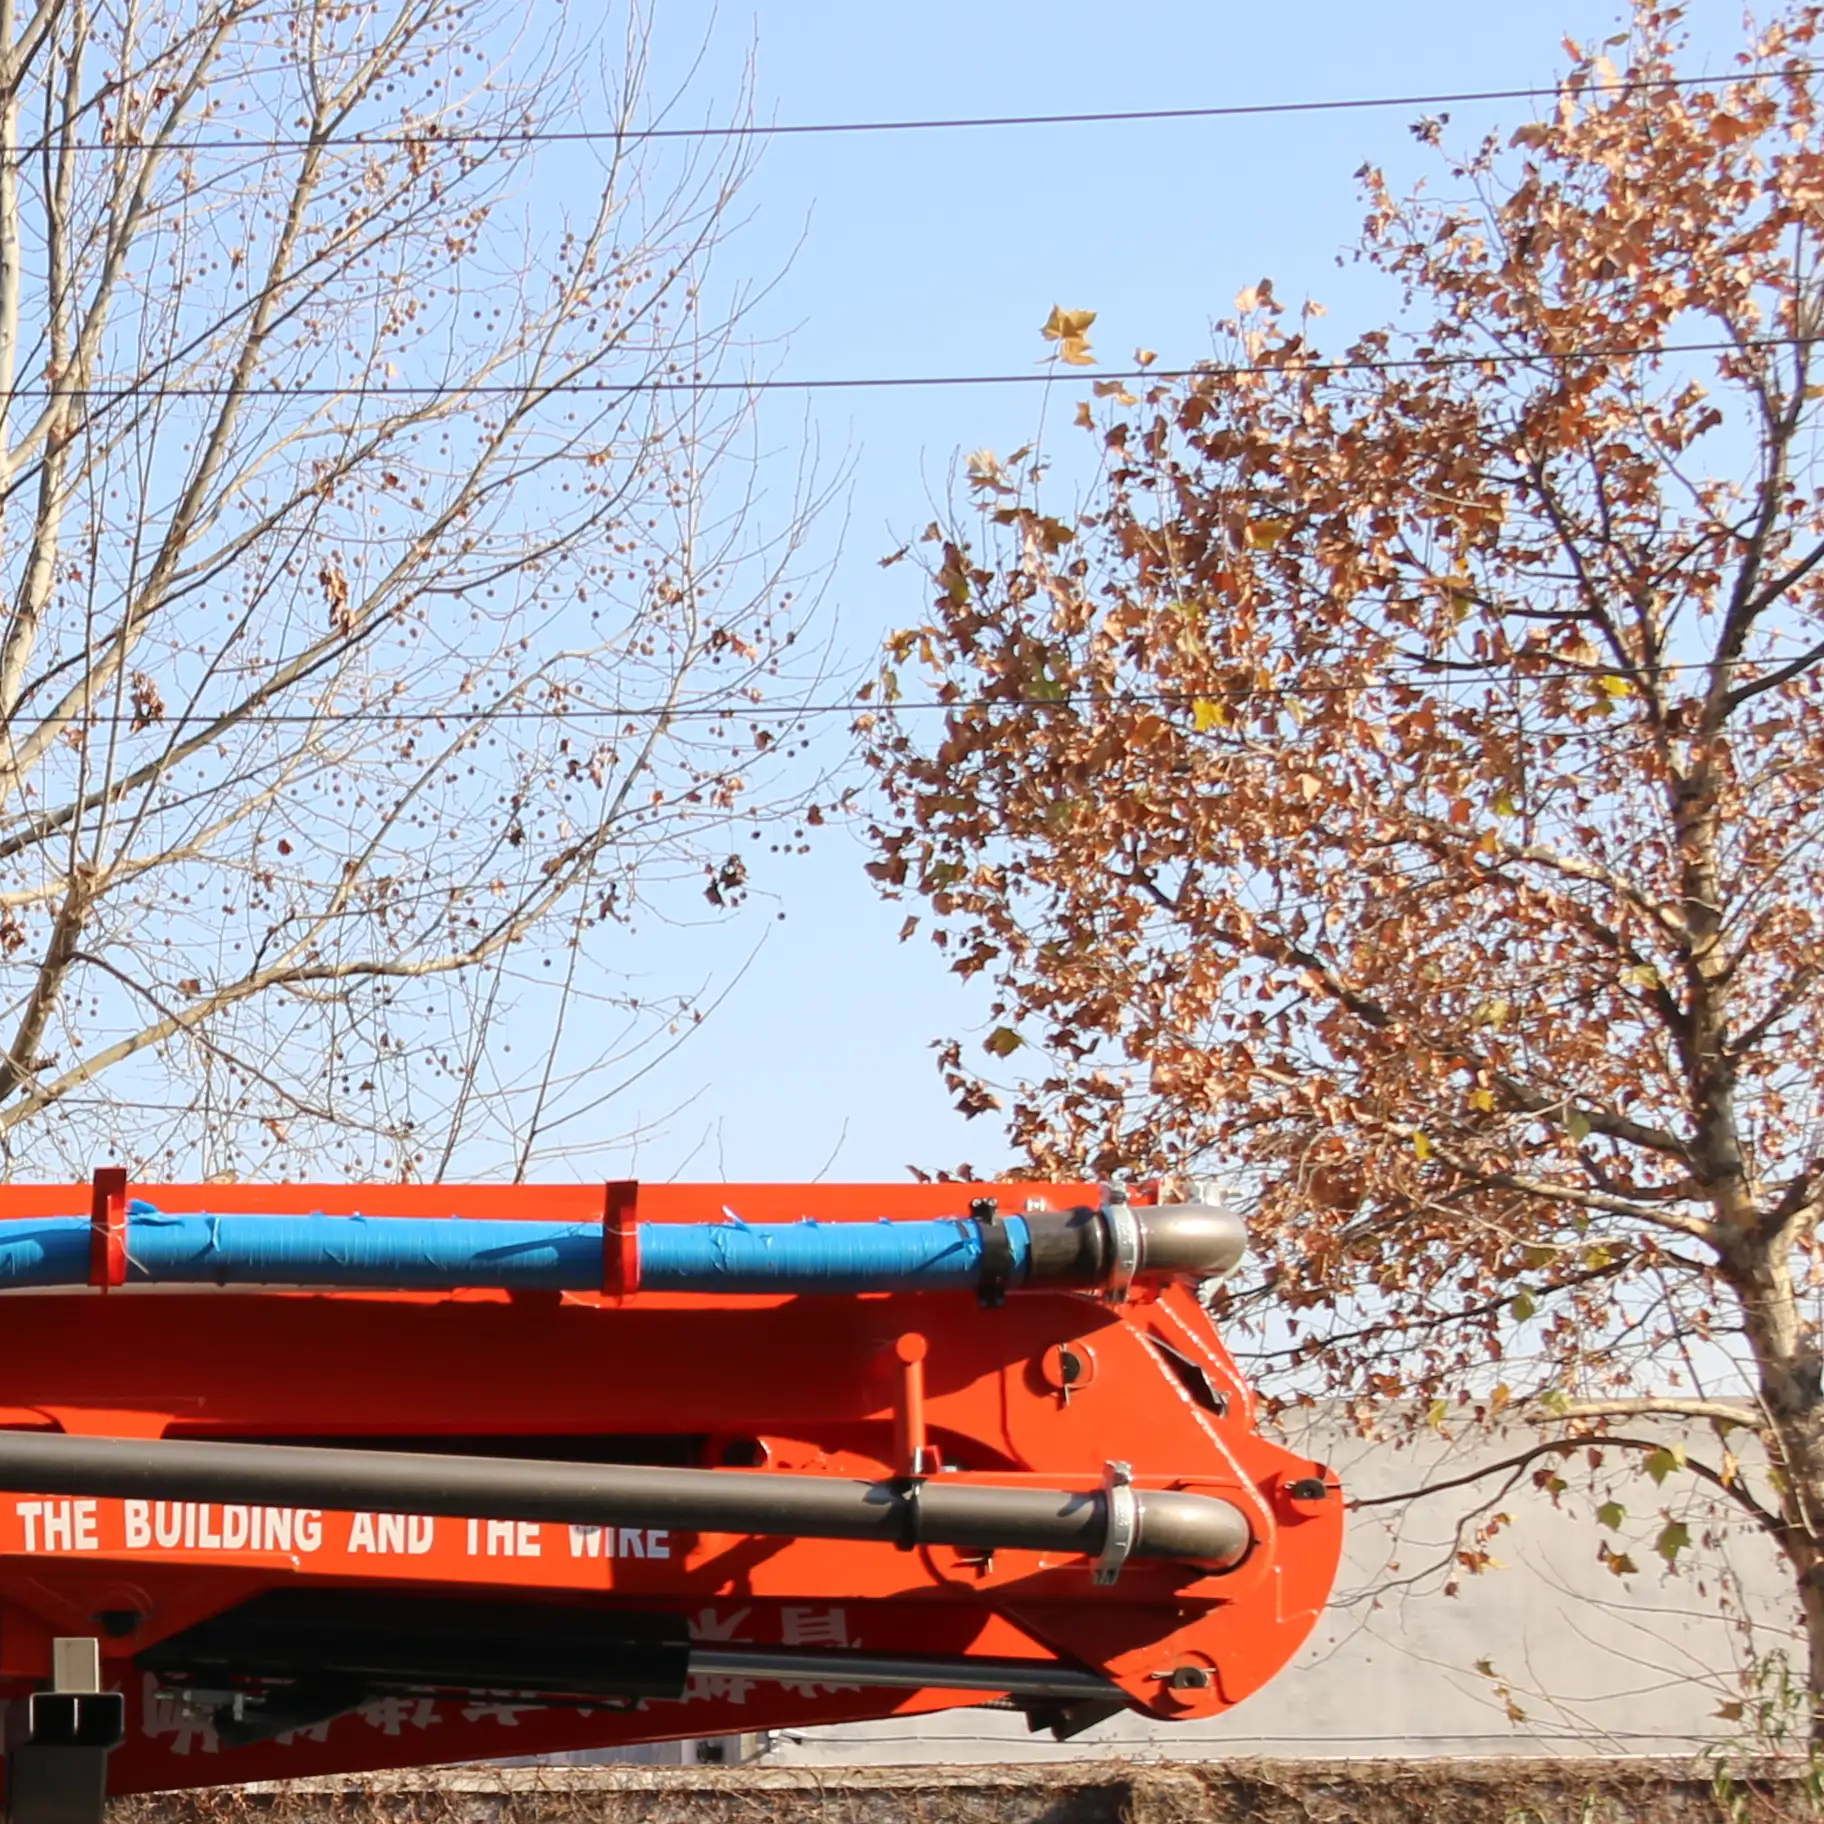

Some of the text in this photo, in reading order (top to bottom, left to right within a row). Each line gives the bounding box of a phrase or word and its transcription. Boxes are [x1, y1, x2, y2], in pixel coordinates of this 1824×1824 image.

[16, 1499, 98, 1551] THE
[124, 1499, 323, 1551] BUILDING
[347, 1511, 433, 1555] AND
